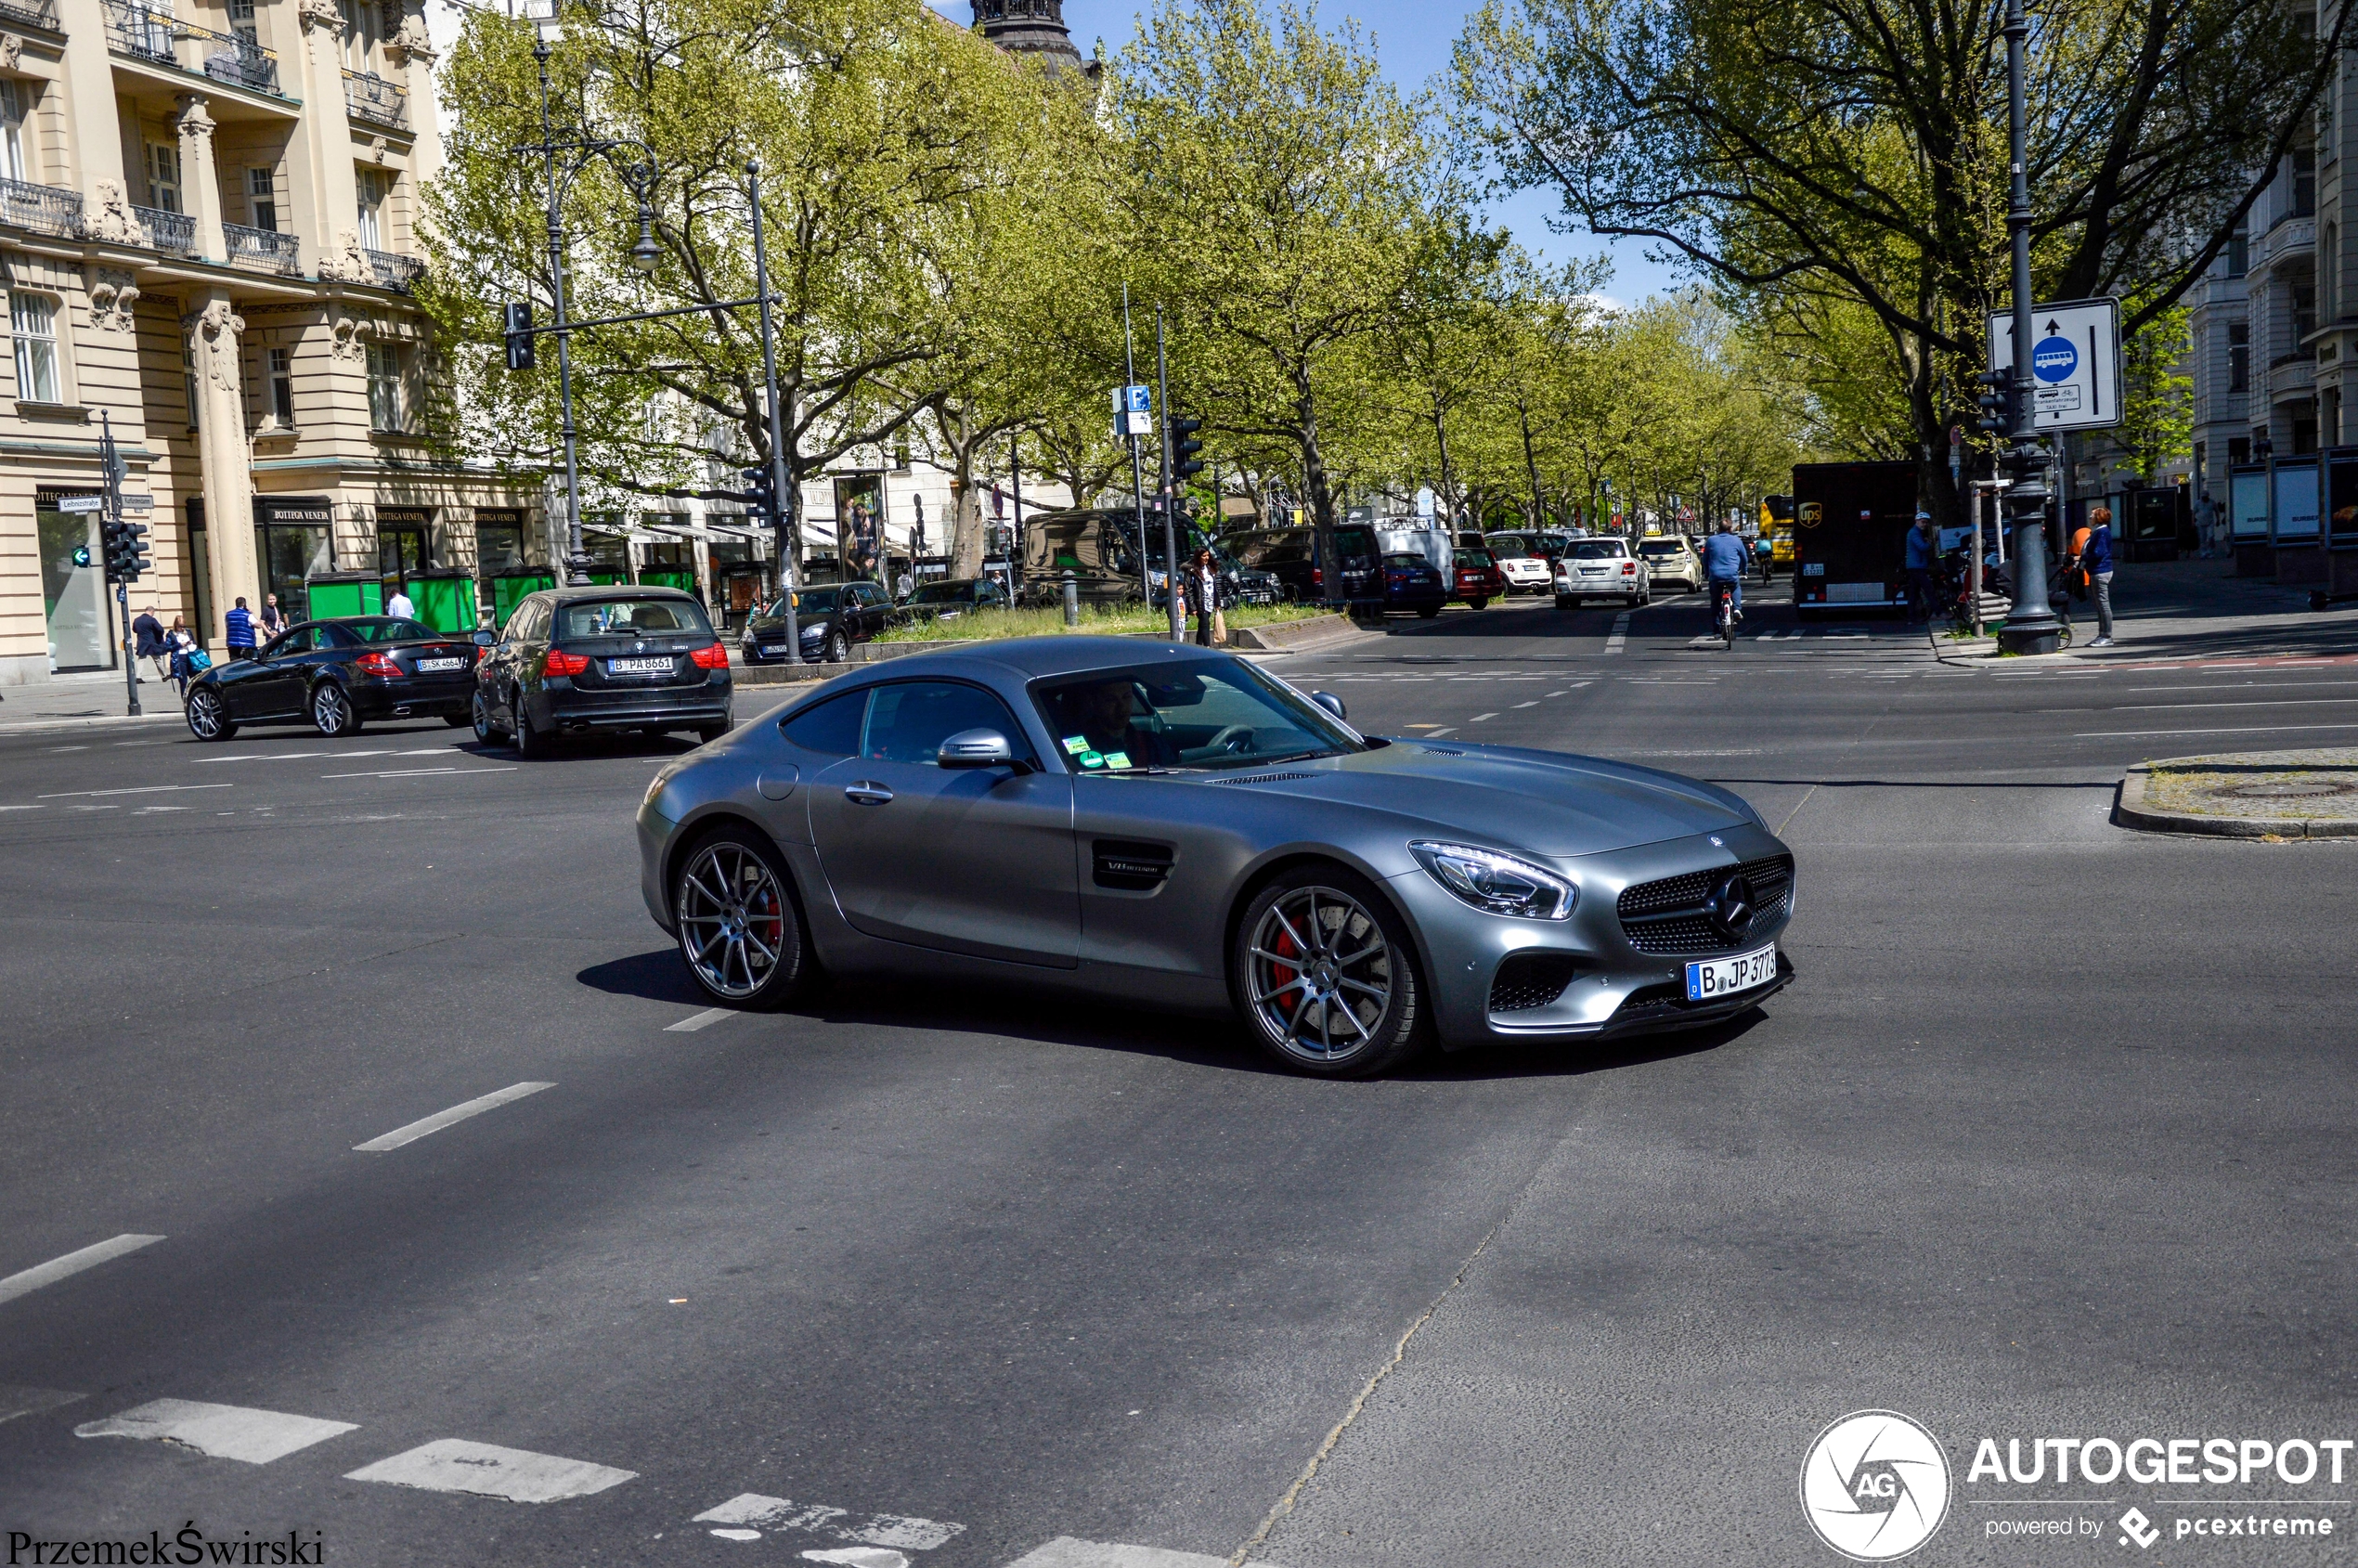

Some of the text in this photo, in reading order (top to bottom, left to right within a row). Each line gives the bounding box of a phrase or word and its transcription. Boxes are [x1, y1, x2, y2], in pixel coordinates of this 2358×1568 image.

[63, 499, 99, 508] Leibnizstraße
[274, 511, 329, 520] BOTTEGA VENETA
[377, 512, 402, 521] BOTTEGA
[474, 513, 516, 522] BOTTEGA VENETA
[1800, 510, 1820, 525] ups
[615, 658, 671, 670] B PA 8661
[1703, 966, 1717, 993] B
[1729, 959, 1748, 988] JP
[1751, 949, 1775, 982] 3773
